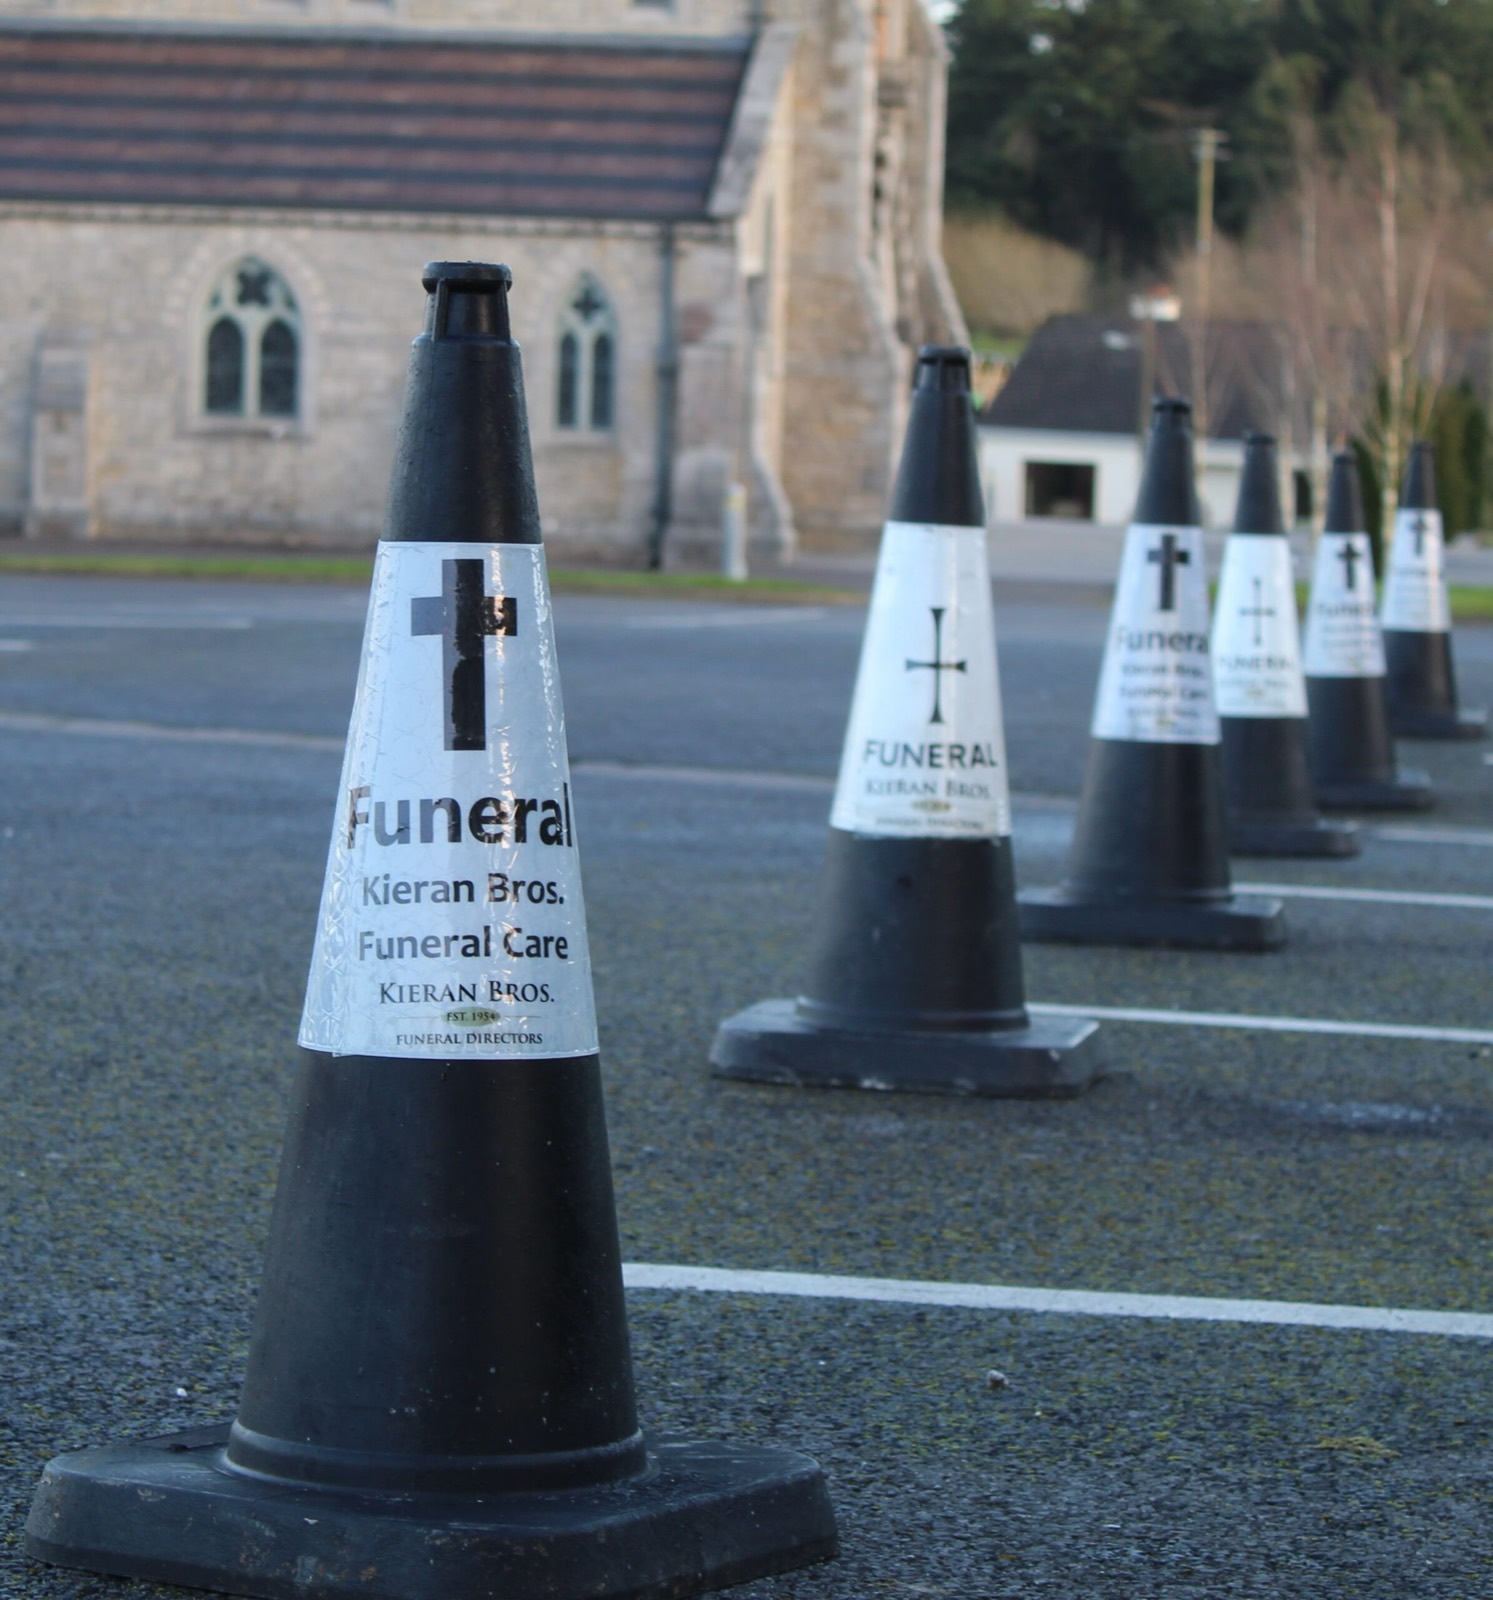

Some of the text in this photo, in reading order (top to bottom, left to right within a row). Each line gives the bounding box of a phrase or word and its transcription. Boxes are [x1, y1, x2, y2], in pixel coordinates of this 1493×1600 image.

[1117, 625, 1209, 655] Funera
[864, 739, 998, 768] FUNERAL
[866, 779, 937, 797] KIERAN
[347, 783, 573, 848] Funeral
[363, 872, 565, 906] Kieran Bros.
[359, 925, 569, 961] Funeral Care
[379, 980, 555, 1004] KIERAN BROS.
[446, 1011, 496, 1022] EST. 1954
[396, 1032, 544, 1046] FUNERAL DIRECTORS
